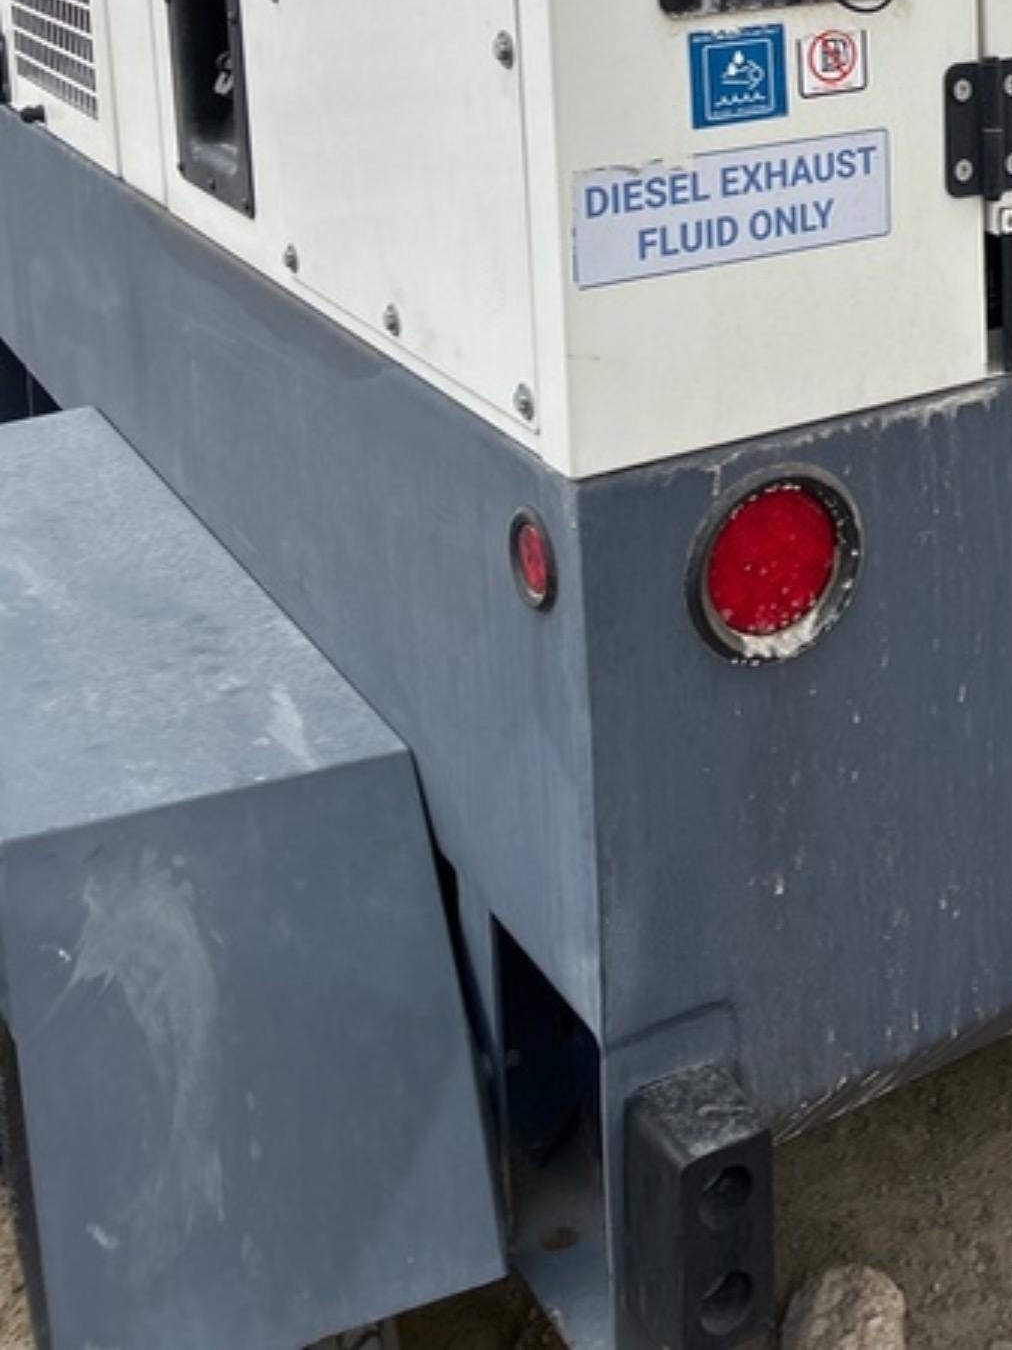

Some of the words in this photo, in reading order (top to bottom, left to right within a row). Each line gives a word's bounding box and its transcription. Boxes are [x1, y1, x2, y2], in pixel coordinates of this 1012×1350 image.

[585, 170, 711, 219] DIESEL
[720, 145, 877, 198] EXHAUST
[637, 214, 739, 261] FLUID
[749, 198, 835, 241] ONLY
